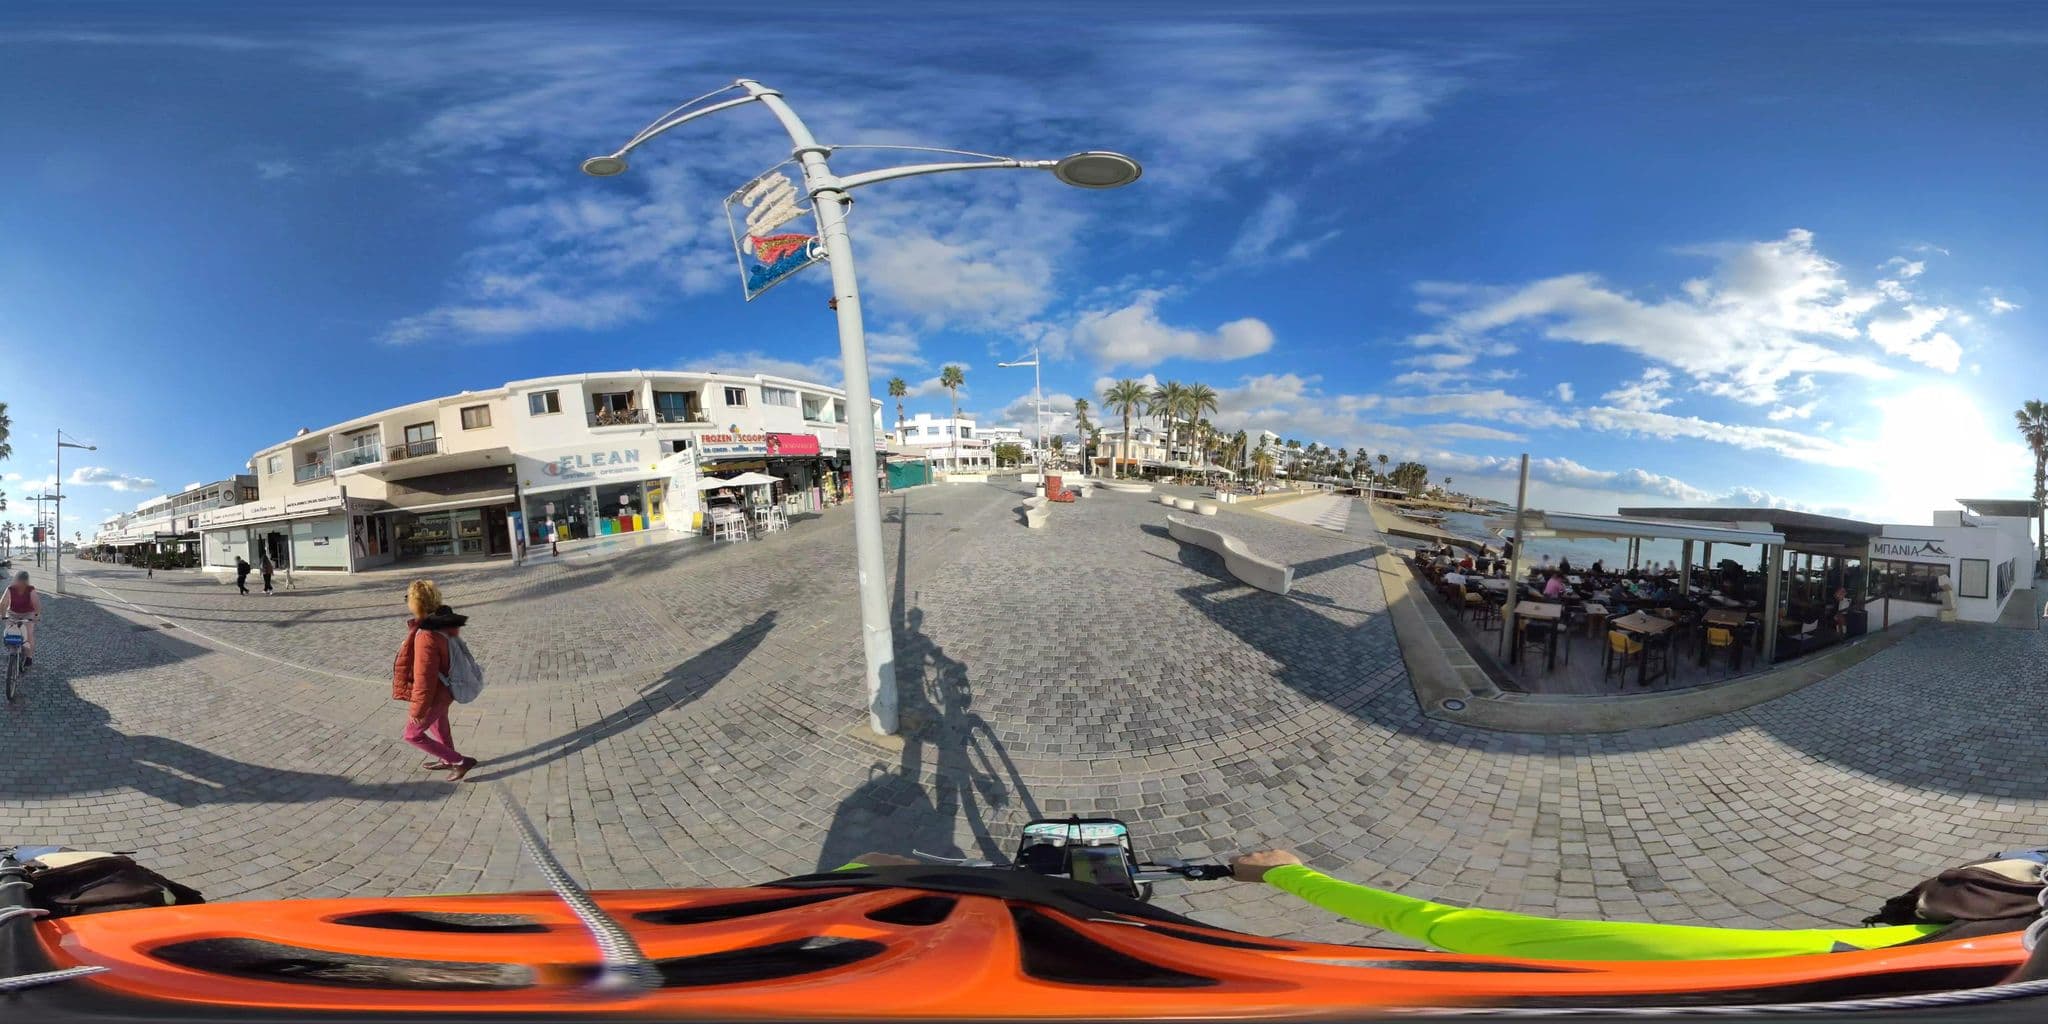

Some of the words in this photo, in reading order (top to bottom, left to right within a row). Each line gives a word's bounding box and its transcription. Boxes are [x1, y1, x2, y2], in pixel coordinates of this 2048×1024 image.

[701, 434, 732, 442] FROZEN
[738, 433, 767, 442] SCOOPS
[1874, 544, 1919, 557] ΜΠΑΝΙΑ
